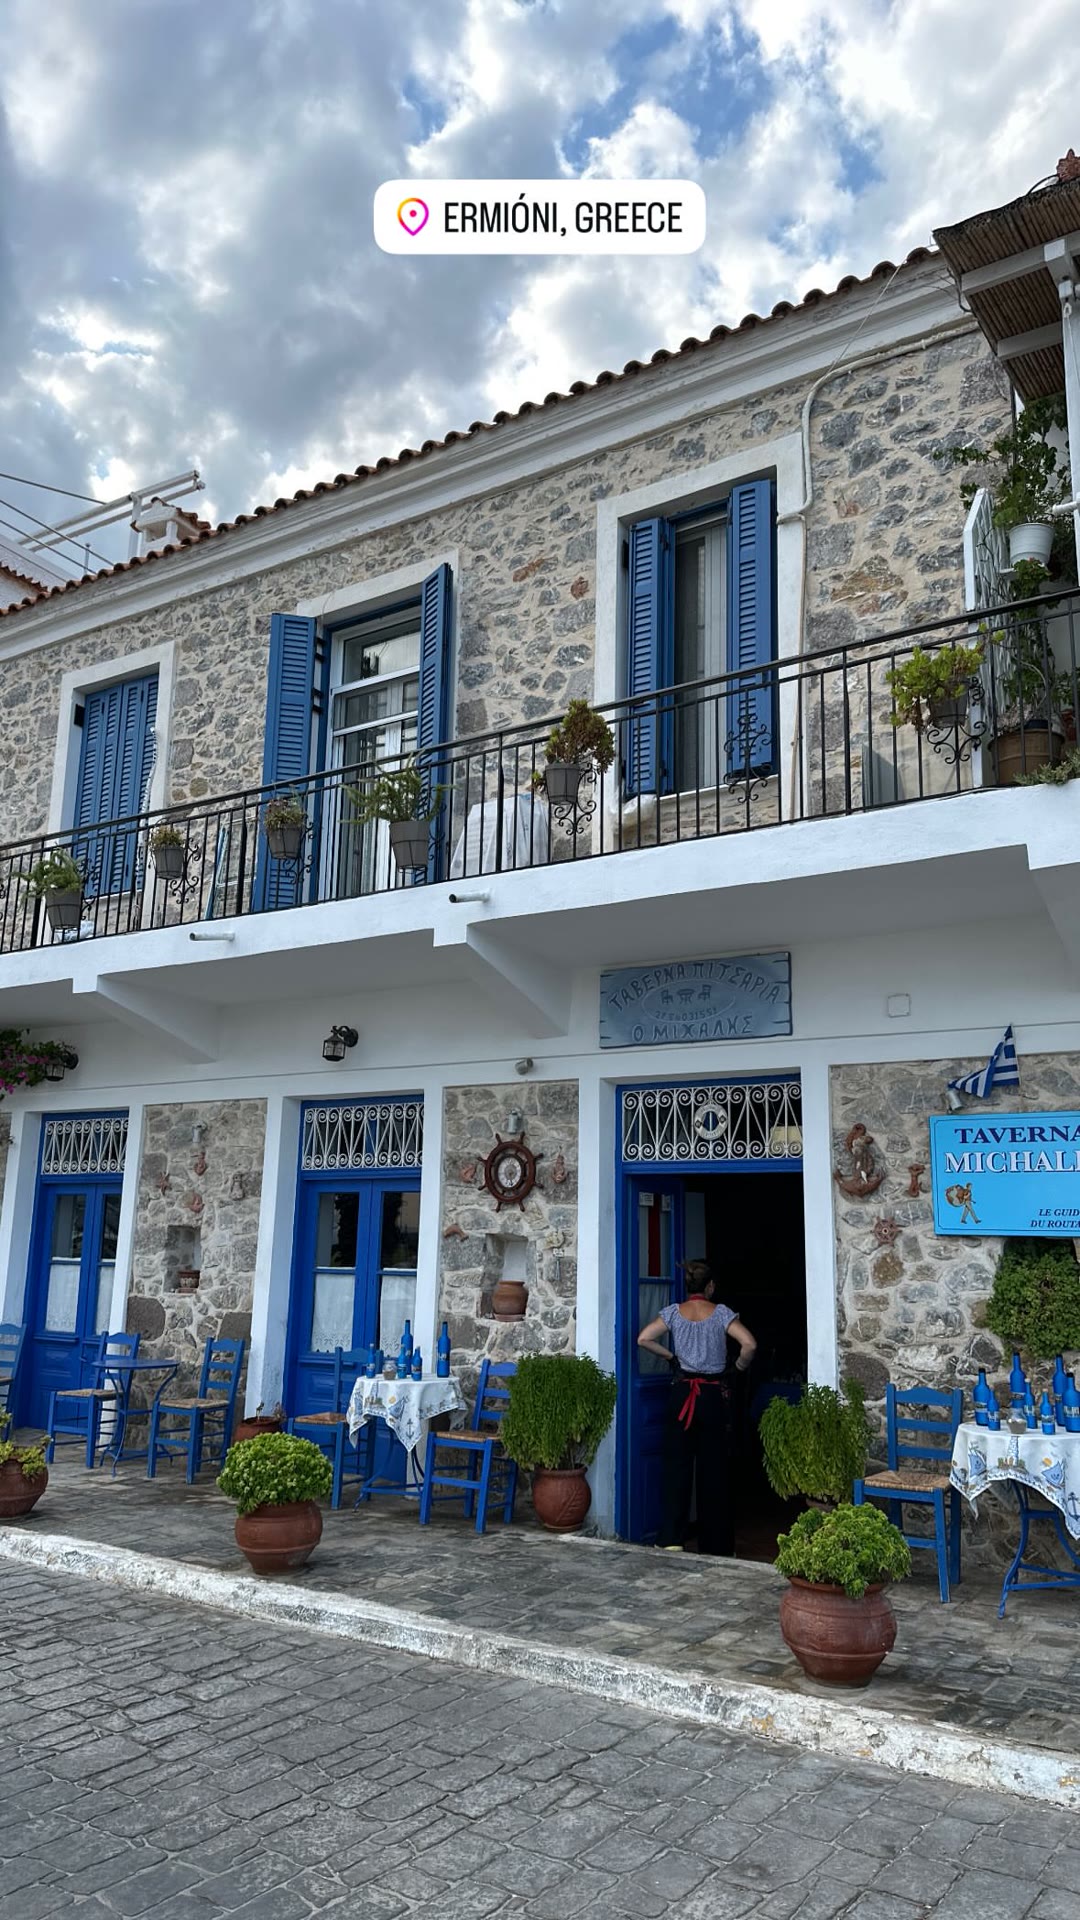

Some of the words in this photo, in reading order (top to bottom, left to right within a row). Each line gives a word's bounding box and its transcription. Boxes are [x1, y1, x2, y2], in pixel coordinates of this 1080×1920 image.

[608, 964, 685, 1011] ΤΑΒΕΡΝΑ
[692, 962, 781, 1004] ΠΙΤΣΑΡΙΑ
[1039, 1208, 1052, 1217] LE
[1030, 1219, 1045, 1228] DU
